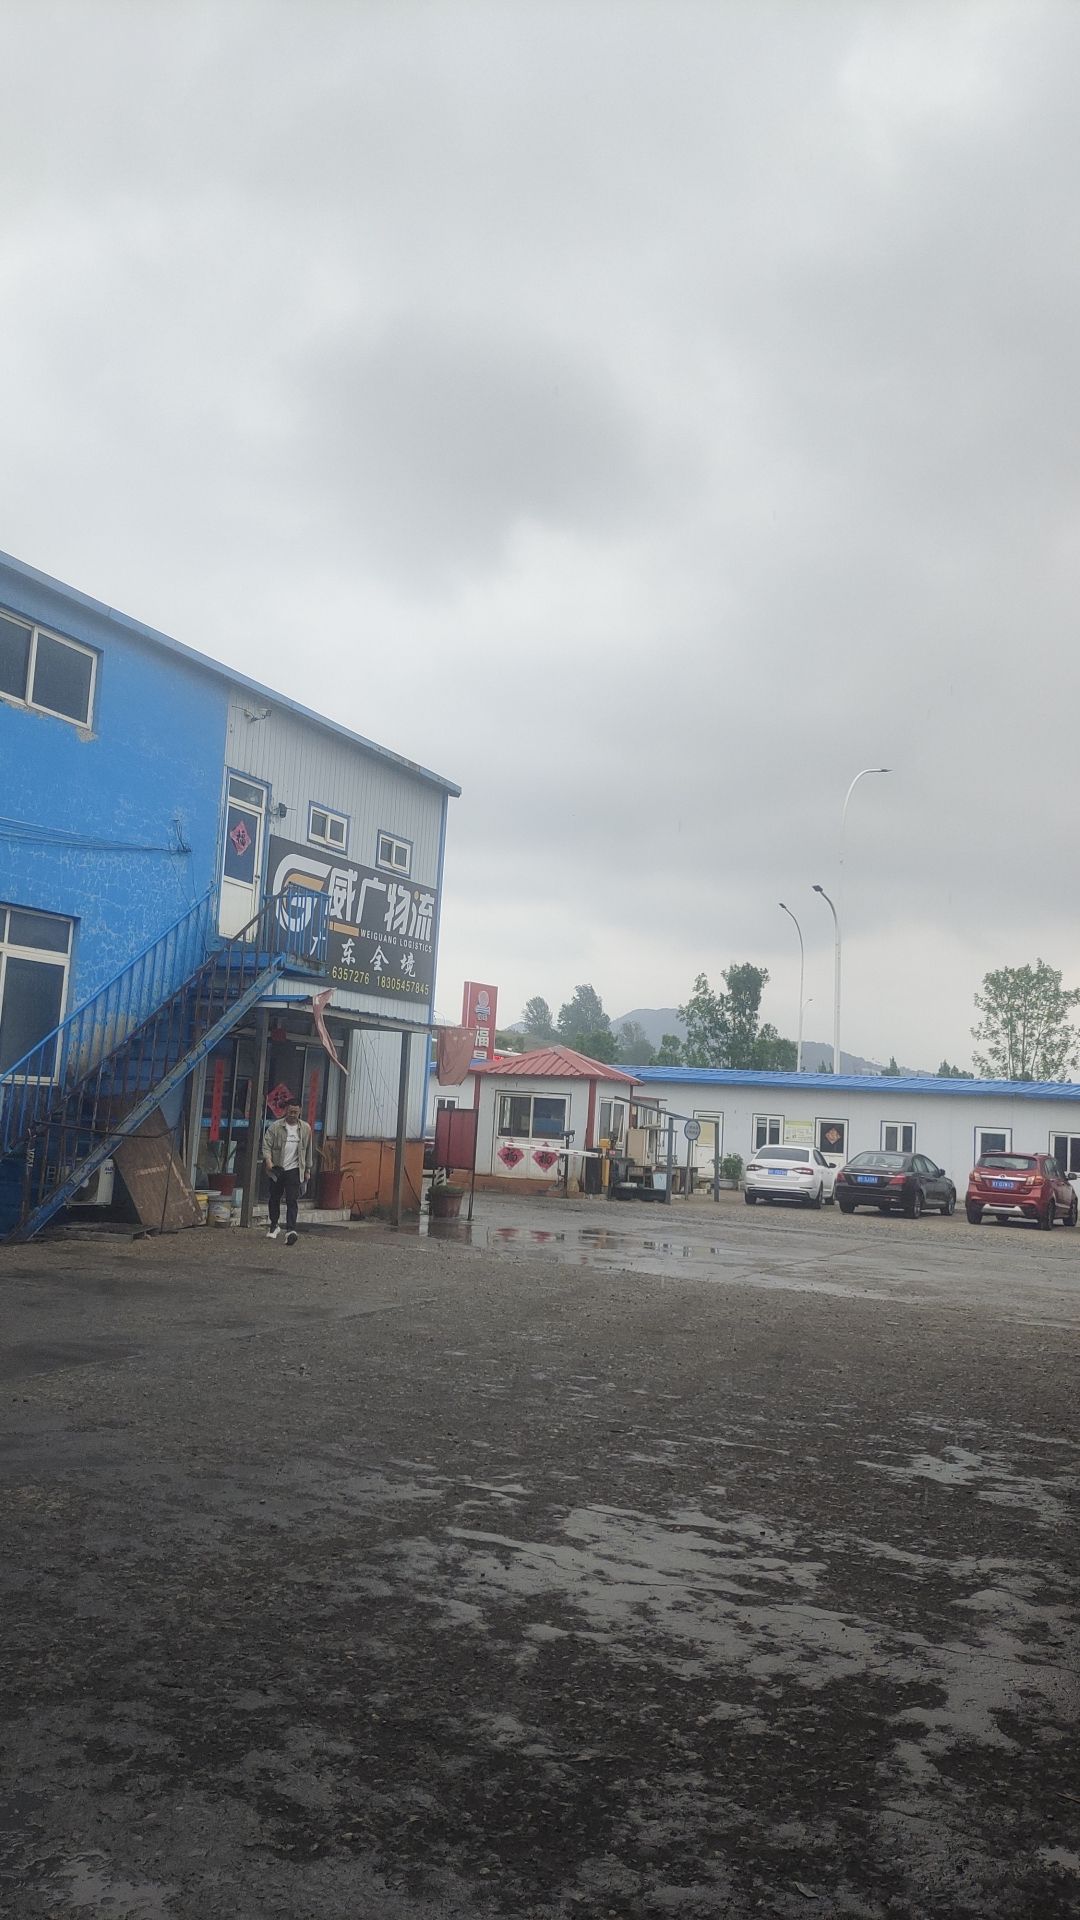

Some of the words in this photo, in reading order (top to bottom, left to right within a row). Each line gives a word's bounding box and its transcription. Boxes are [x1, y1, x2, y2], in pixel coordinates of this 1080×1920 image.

[328, 867, 435, 941] 威广物流
[360, 928, 397, 944] WEIGUANG
[399, 940, 433, 953] LOGISTICS
[377, 975, 429, 996] 18305457845
